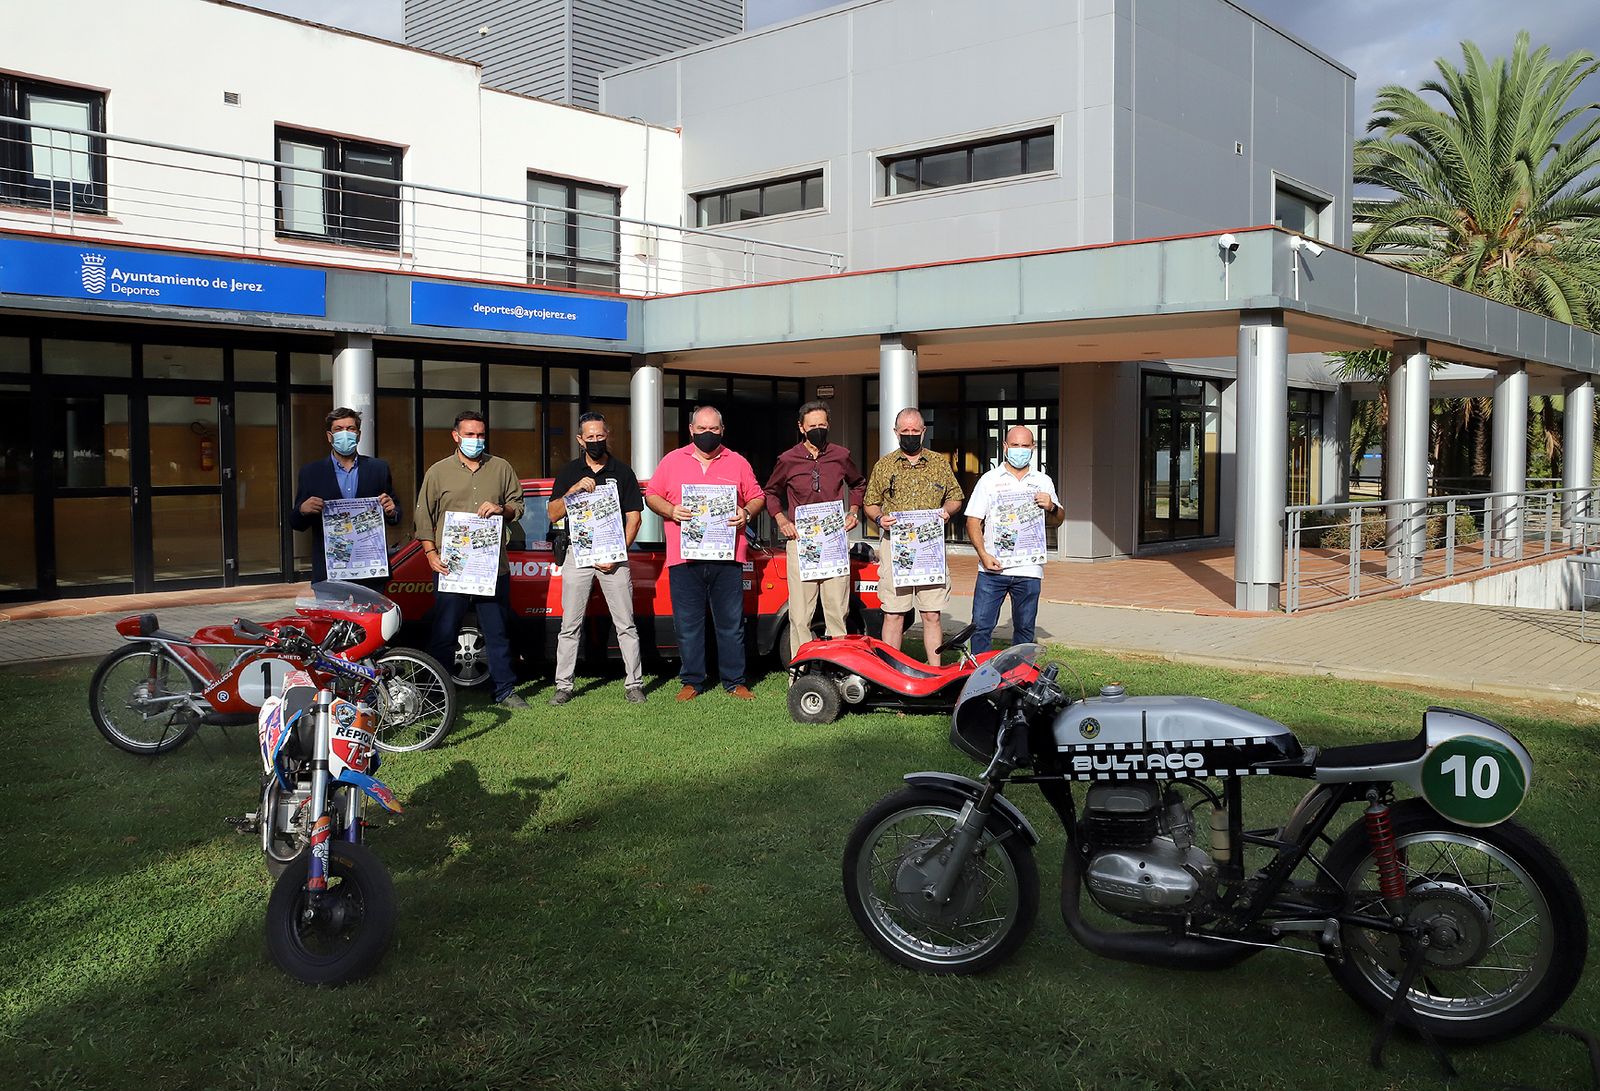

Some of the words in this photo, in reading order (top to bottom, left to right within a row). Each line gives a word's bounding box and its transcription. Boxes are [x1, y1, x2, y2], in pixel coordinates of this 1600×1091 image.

[111, 268, 209, 287] Ayuntamiento
[212, 278, 228, 289] de
[230, 279, 263, 292] Jerez
[111, 283, 160, 296] Deportes
[473, 303, 577, 320] deportes@aytojerez.es
[509, 561, 562, 577] MOTU
[260, 662, 272, 699] 1
[1072, 753, 1204, 771] BULTACO
[1441, 755, 1500, 799] 10
